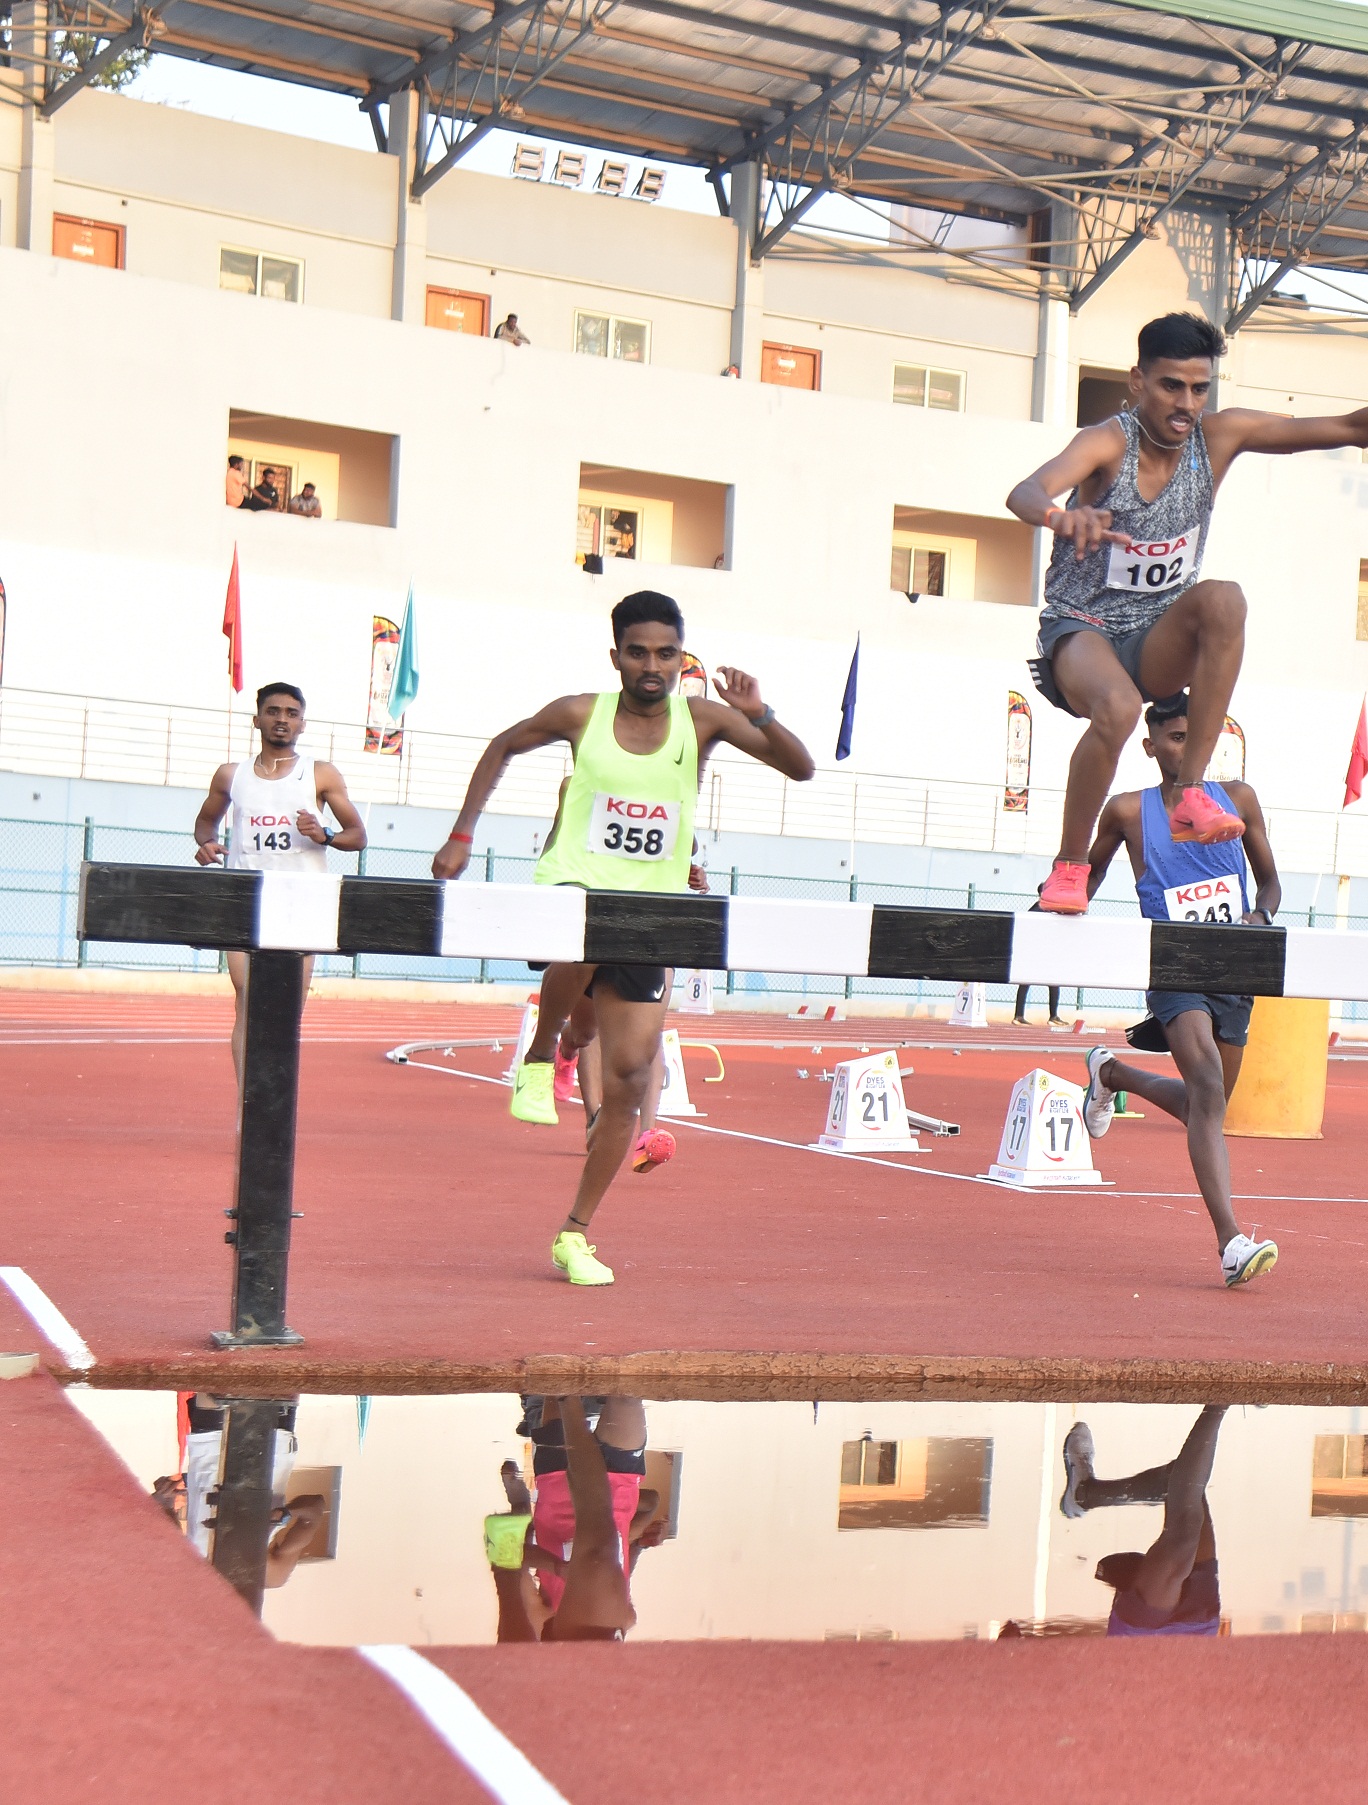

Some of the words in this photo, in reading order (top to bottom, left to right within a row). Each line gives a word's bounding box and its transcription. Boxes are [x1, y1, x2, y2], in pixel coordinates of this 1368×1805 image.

[1125, 537, 1187, 556] KOA
[1127, 557, 1183, 587] 102
[607, 797, 668, 820] KOA
[250, 815, 292, 826] KOA
[253, 831, 291, 851] 143
[604, 822, 664, 855] 358
[1176, 881, 1230, 904] KOA
[693, 983, 700, 999] 8
[962, 997, 968, 1011] 7
[833, 1090, 845, 1121] 21
[861, 1092, 888, 1122] 21
[1050, 1100, 1068, 1108] DYES
[1010, 1114, 1027, 1151] 17
[1045, 1116, 1074, 1152] 17
